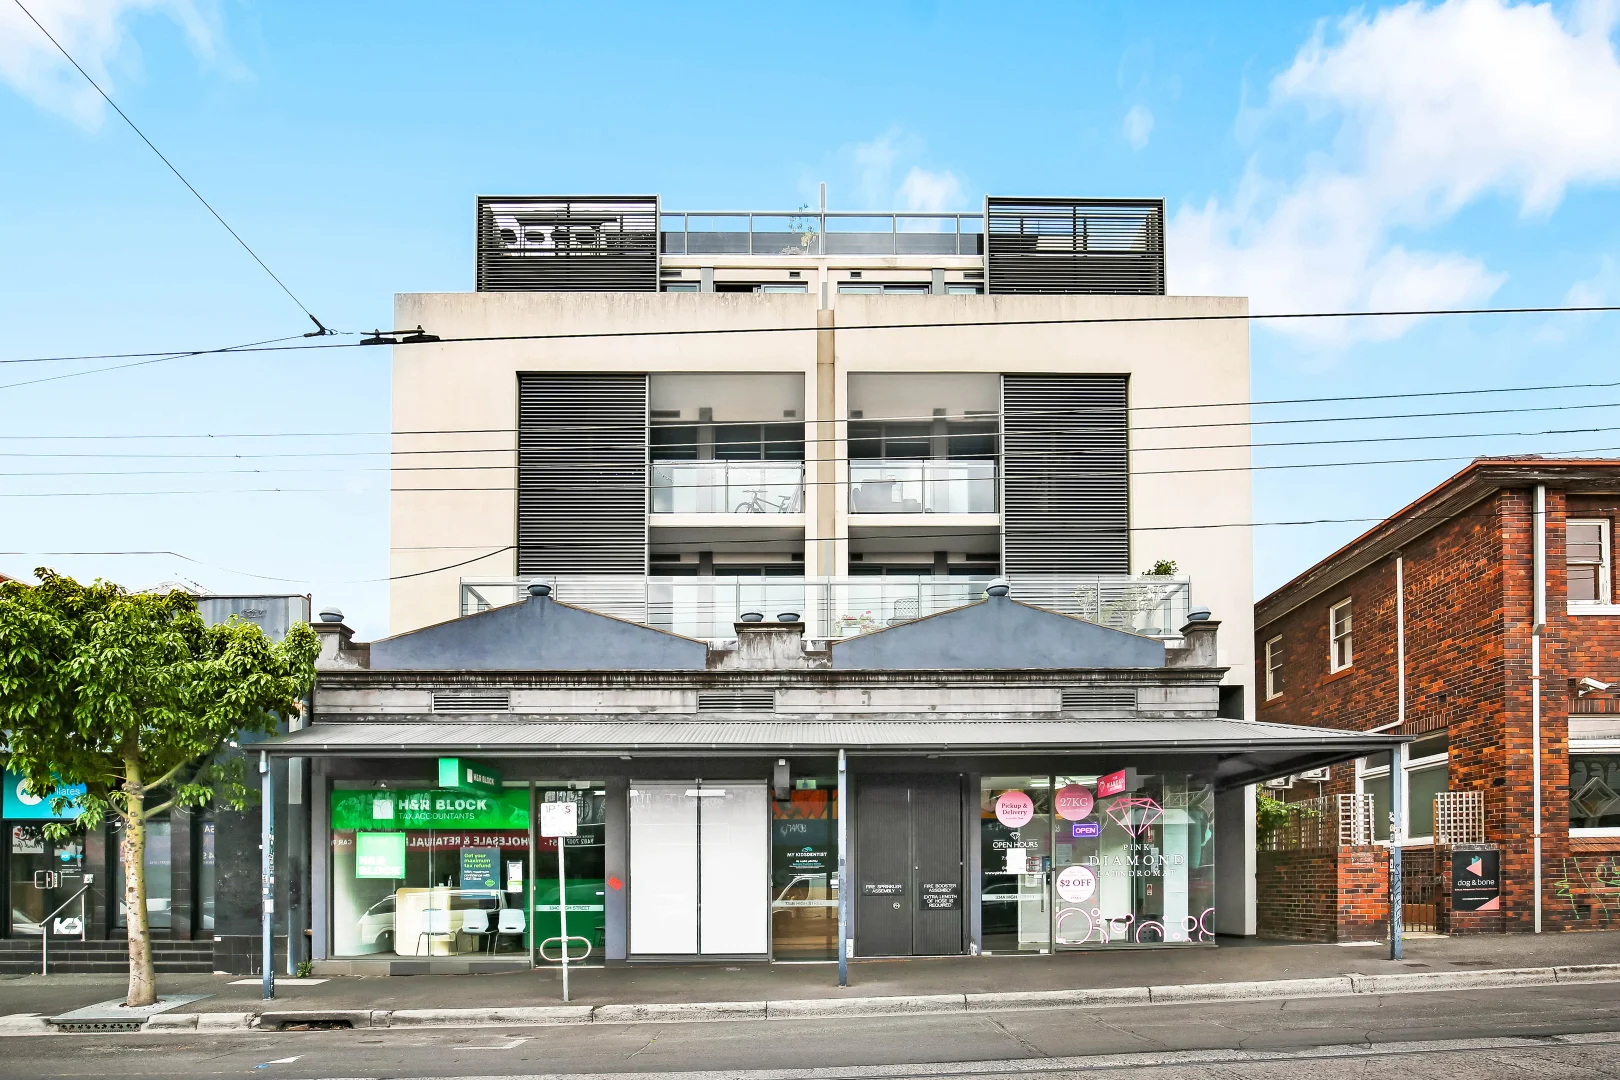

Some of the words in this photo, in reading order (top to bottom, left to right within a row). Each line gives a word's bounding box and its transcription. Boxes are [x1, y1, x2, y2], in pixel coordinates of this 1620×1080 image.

[482, 775, 495, 785] BLOCK
[398, 799, 430, 811] H&R
[435, 799, 487, 811] BLOCK
[1060, 797, 1088, 807] 27KG
[398, 812, 412, 820] TAX
[414, 812, 475, 820] ACCOUNTANTS
[992, 841, 1012, 849] OPEN
[1123, 843, 1150, 851] PINK
[1088, 854, 1184, 866] DIAMOND
[1097, 869, 1176, 877] LAUNDROMAT
[1059, 879, 1070, 888] $2
[1072, 879, 1092, 887] OFF
[1457, 879, 1471, 887] dog
